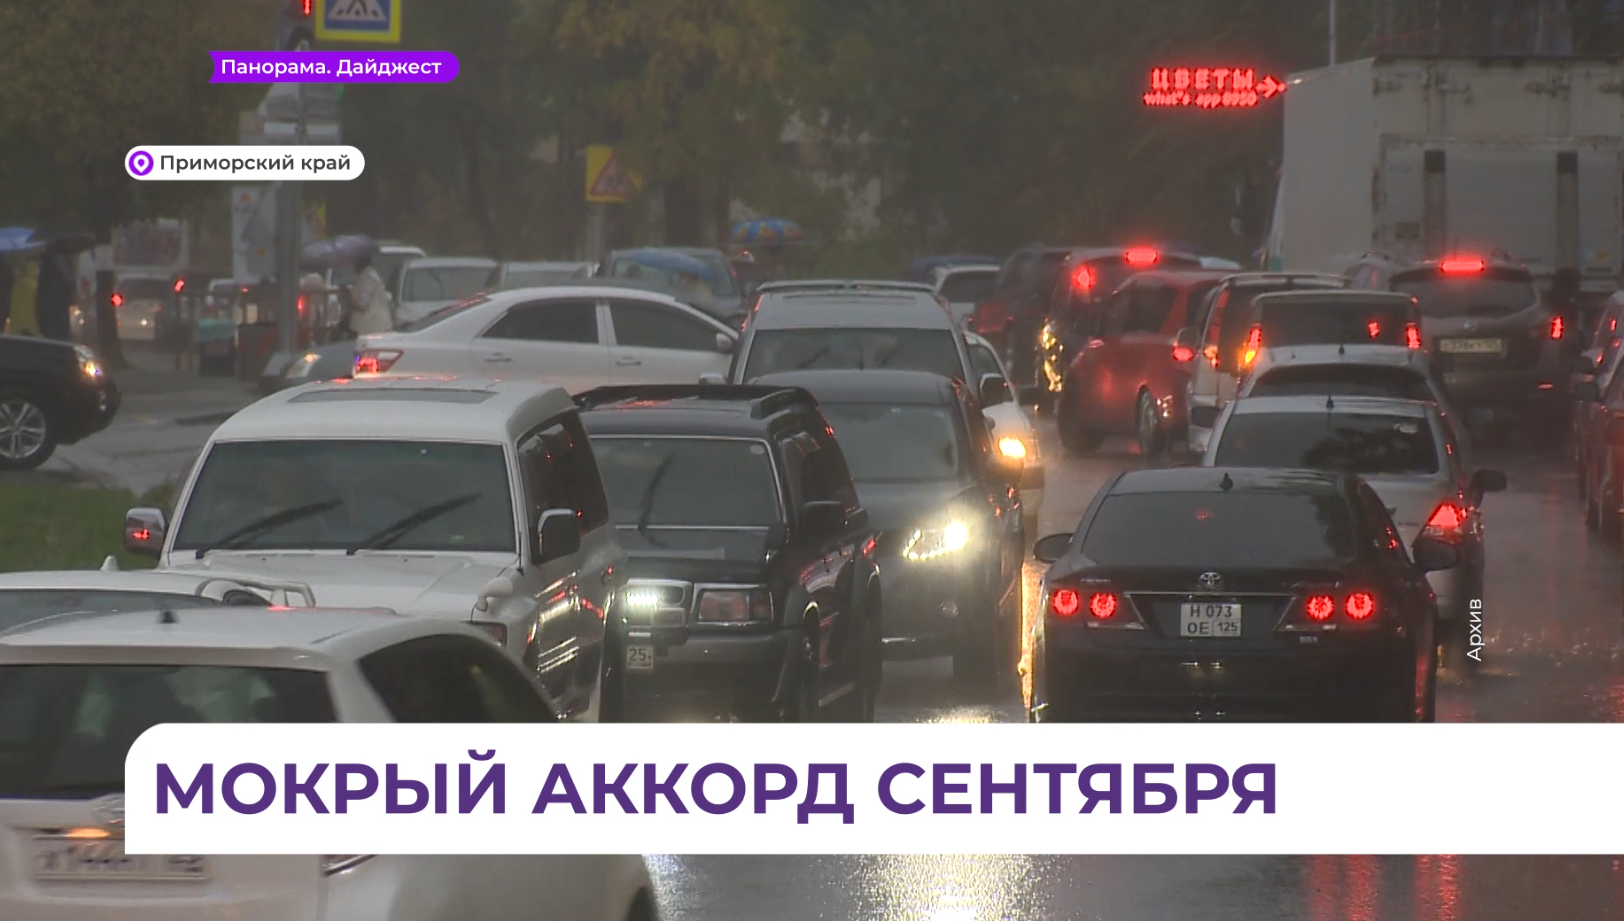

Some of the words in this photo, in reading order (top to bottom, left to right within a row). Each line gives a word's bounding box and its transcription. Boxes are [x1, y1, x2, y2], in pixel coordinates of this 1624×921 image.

[1152, 68, 1255, 91] ЦВЕТЫ
[1205, 604, 1232, 618] 073
[1217, 621, 1239, 632] 125
